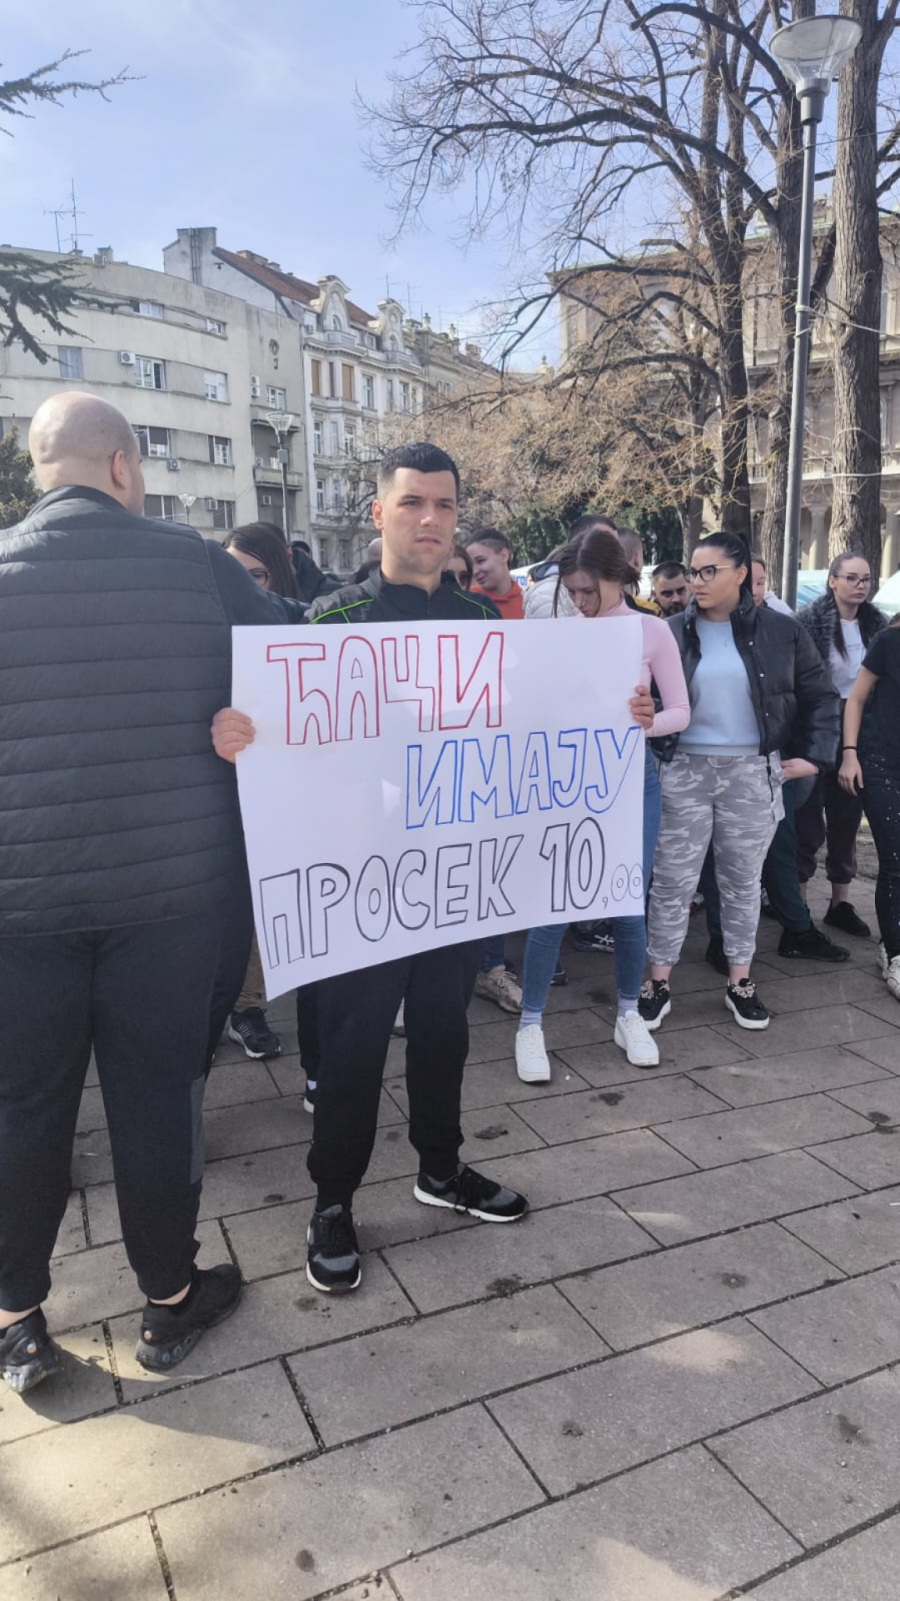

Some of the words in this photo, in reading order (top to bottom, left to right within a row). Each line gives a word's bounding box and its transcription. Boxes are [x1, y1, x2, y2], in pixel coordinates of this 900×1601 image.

[406, 727, 641, 829] ИМАЈУ
[260, 834, 524, 969] ПРОСЕК
[539, 817, 643, 912] 10,00
